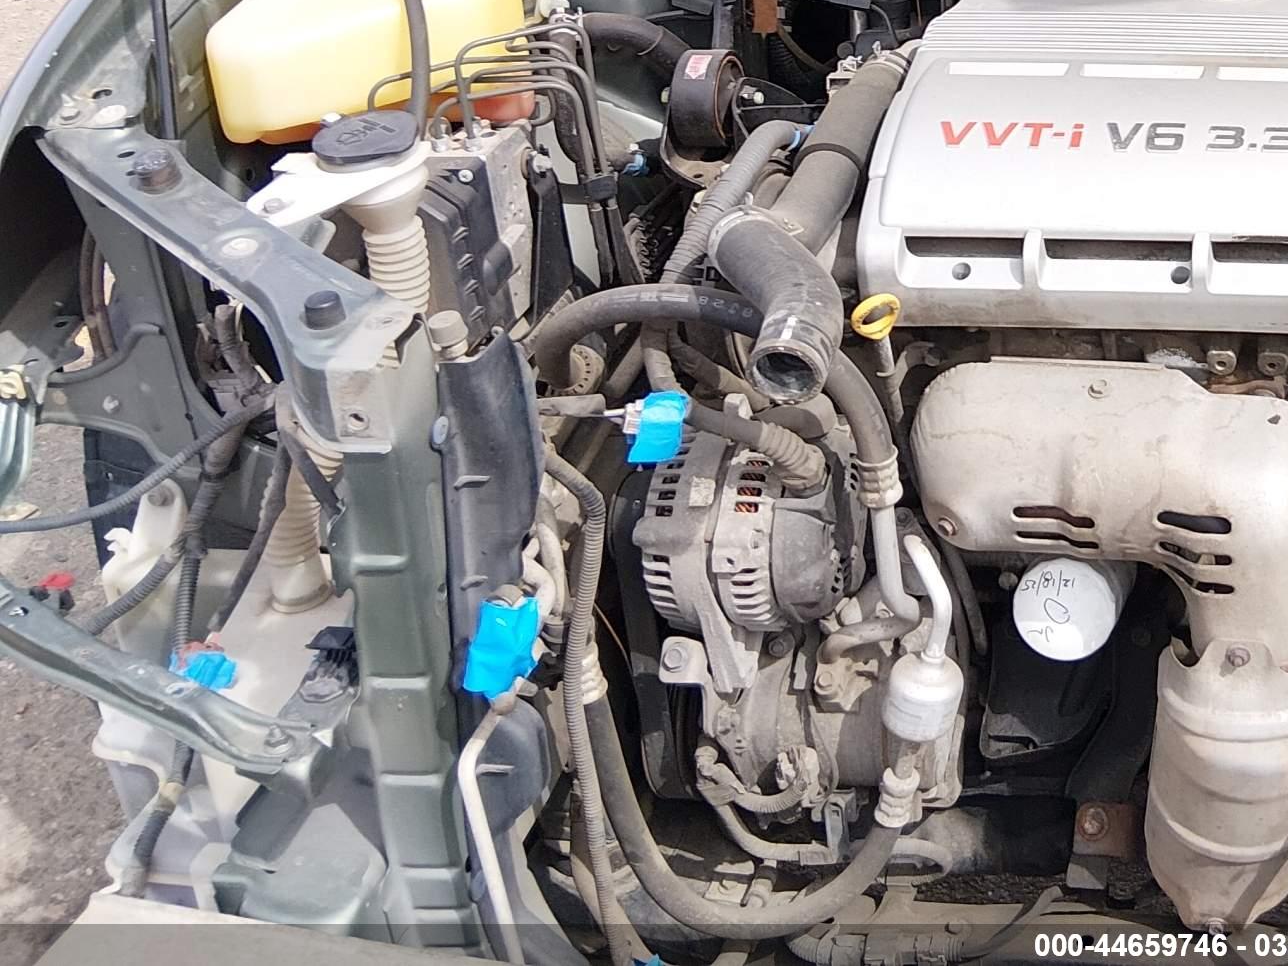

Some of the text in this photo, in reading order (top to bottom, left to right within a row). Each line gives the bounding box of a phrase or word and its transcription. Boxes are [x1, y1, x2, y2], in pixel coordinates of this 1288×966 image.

[940, 121, 1084, 148] VVT-i
[1107, 122, 1187, 151] V6
[1019, 569, 1076, 596] 12/18/25
